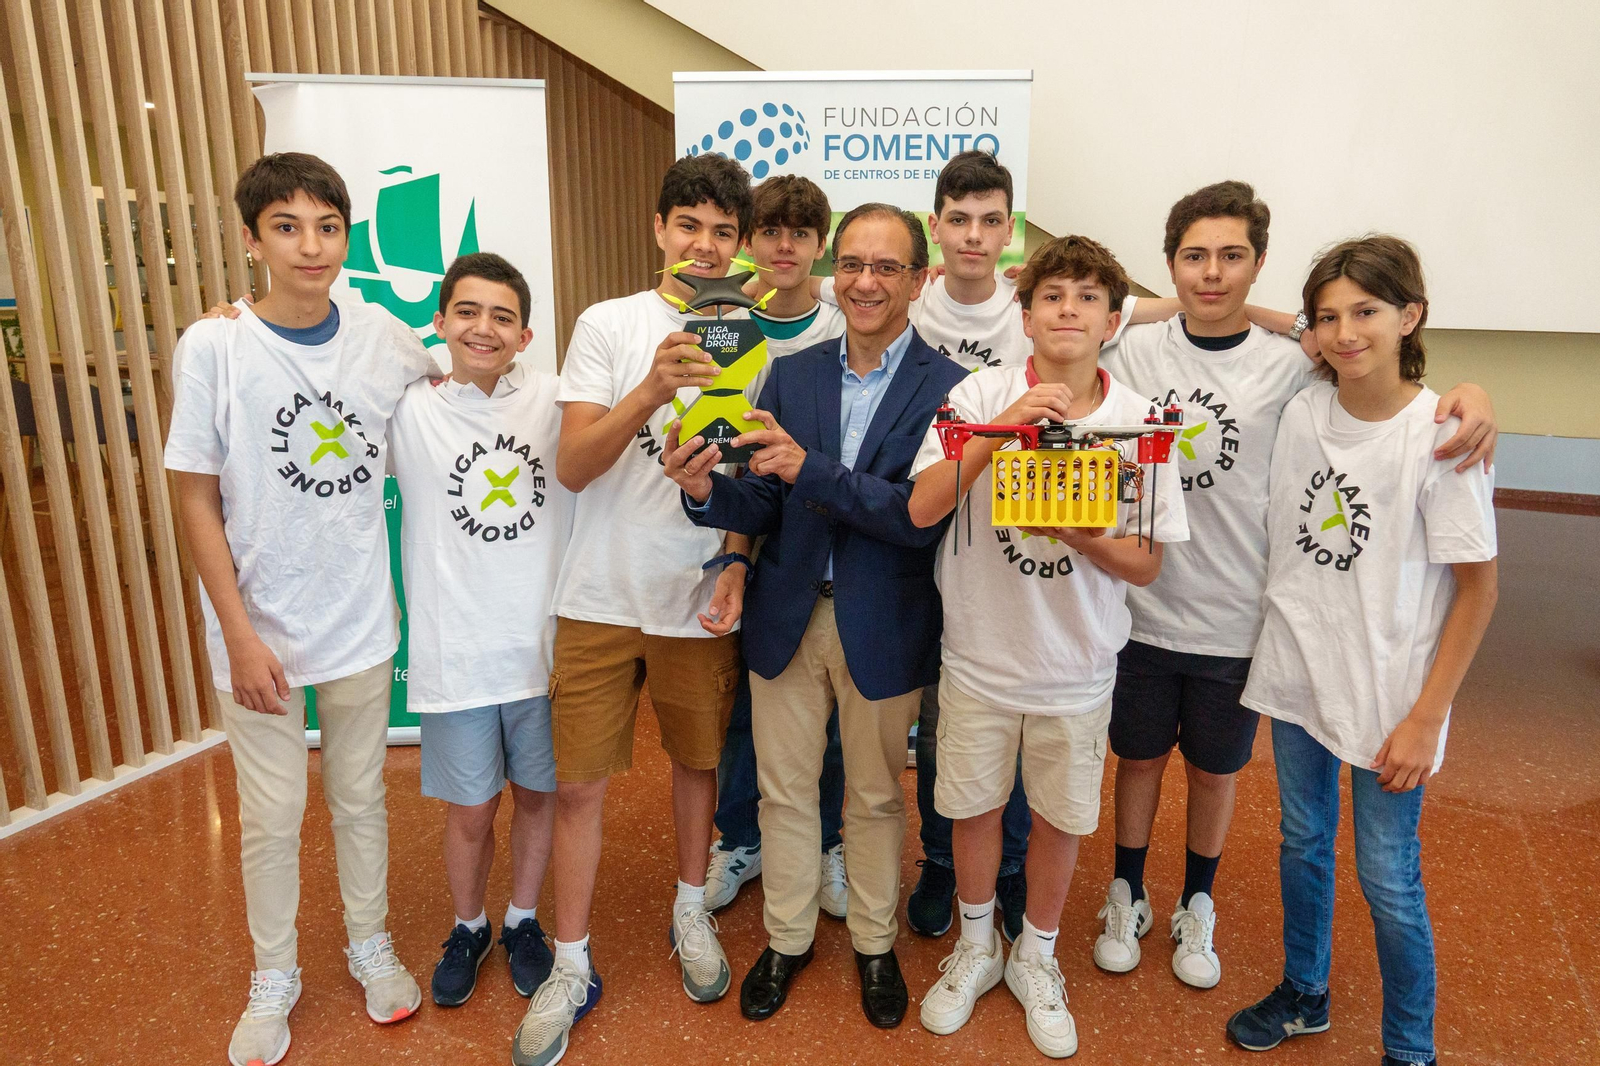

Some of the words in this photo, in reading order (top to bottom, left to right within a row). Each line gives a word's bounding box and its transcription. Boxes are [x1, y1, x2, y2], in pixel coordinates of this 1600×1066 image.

[824, 102, 998, 127] FUNDACIÓN
[824, 133, 1000, 161] FOMENTO
[824, 169, 840, 180] DE
[844, 169, 900, 180] CENTROS
[904, 169, 920, 180] DE
[697, 326, 707, 334] IV
[708, 326, 728, 334] LIGA
[705, 340, 738, 348] DRONE
[706, 332, 740, 341] MAKER
[958, 338, 1002, 368] MAK
[271, 392, 313, 453] LIGA
[1188, 388, 1240, 471] MAKER
[277, 461, 372, 498] DRONE
[447, 441, 488, 497] LIGA
[495, 433, 546, 507] MAKER
[450, 505, 535, 542] DRONE
[995, 528, 1074, 579] DRONE
